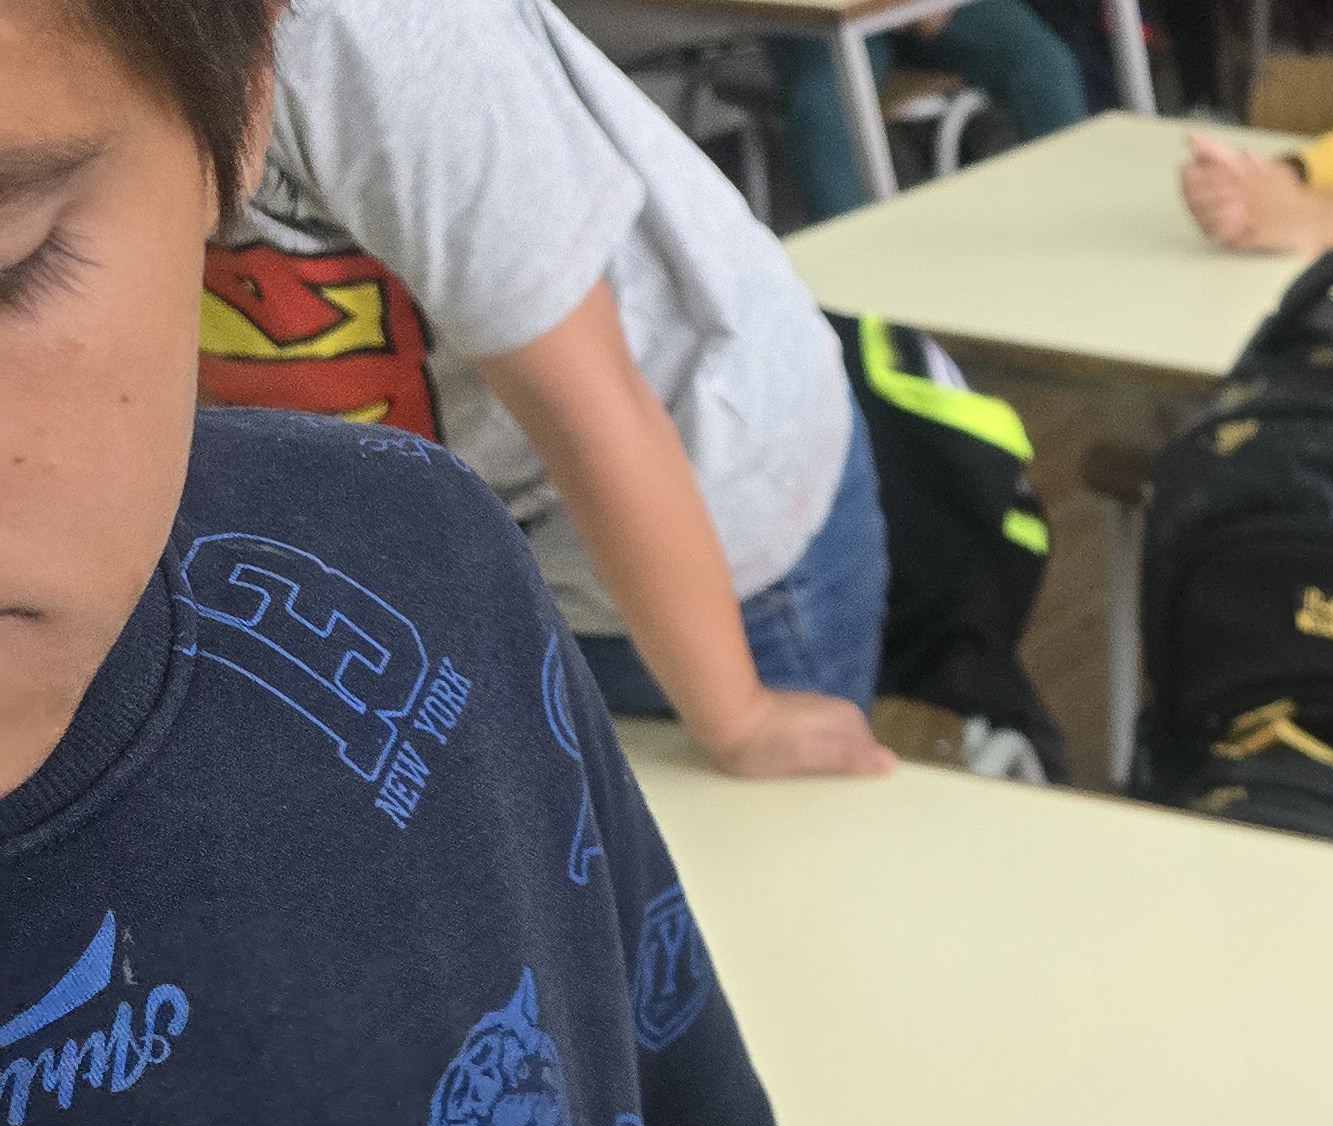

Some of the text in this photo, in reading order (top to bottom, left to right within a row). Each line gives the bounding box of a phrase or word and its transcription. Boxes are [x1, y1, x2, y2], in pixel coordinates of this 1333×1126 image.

[374, 656, 473, 829] NEW YORK
[0, 983, 189, 1126] Athl
